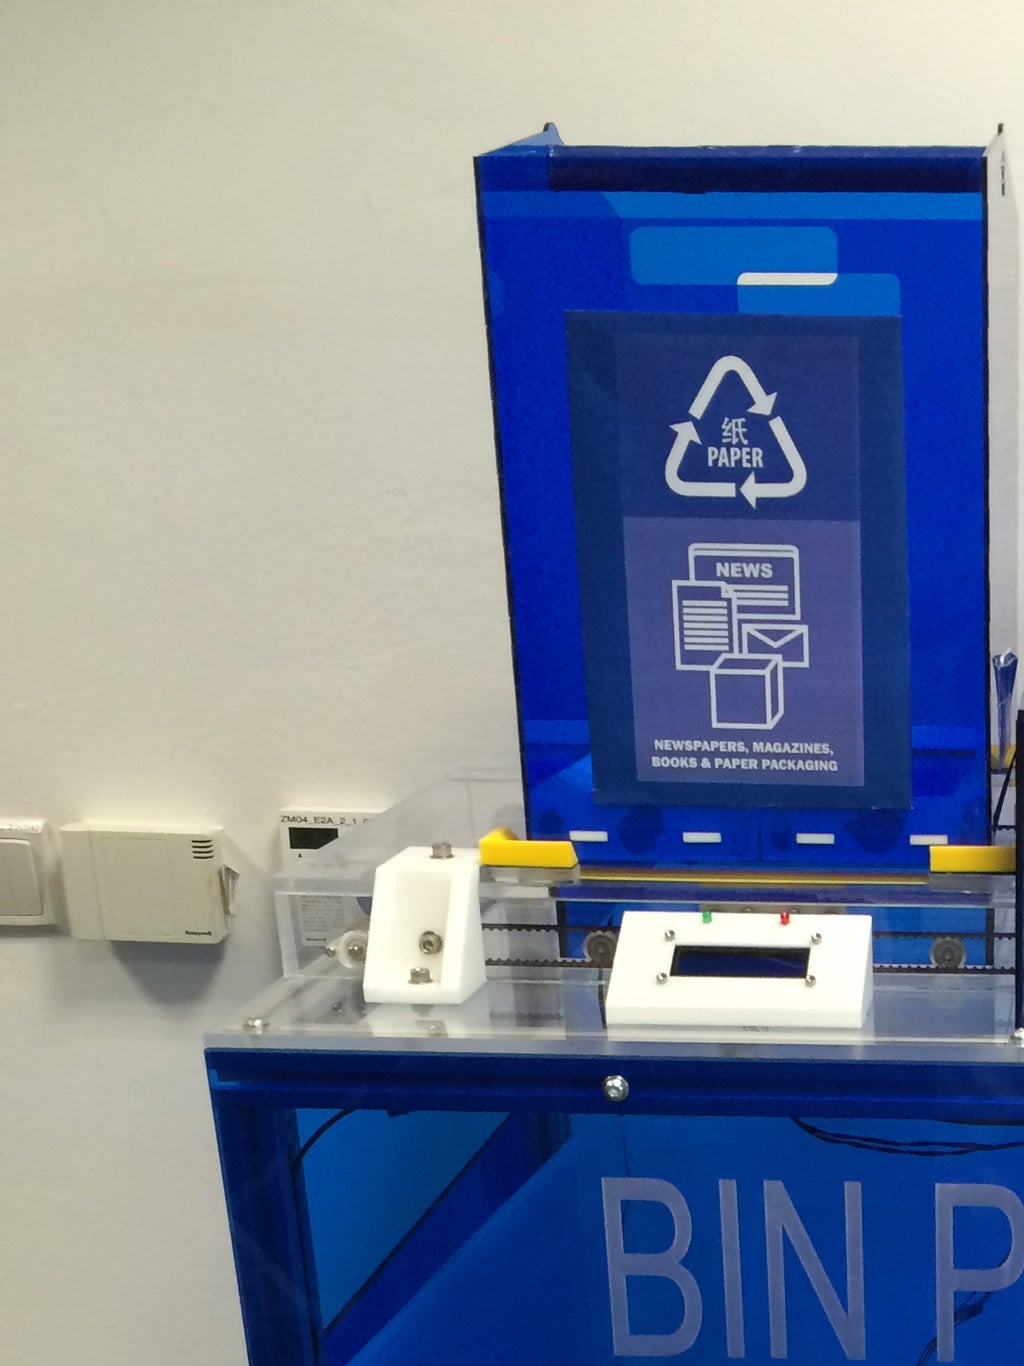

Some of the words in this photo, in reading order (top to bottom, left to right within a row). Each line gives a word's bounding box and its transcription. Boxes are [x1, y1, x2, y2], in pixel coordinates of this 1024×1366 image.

[722, 416, 749, 446] 纸
[707, 446, 764, 468] PAPER
[715, 562, 773, 578] NEWS
[654, 739, 749, 755] NEWSPAPERS,
[752, 742, 834, 756] MAGAZINES,
[651, 756, 698, 768] BOOKS
[701, 757, 711, 769] &
[714, 758, 758, 770] PAPER
[762, 759, 838, 772] PACKAGING
[602, 1177, 866, 1361] BIN
